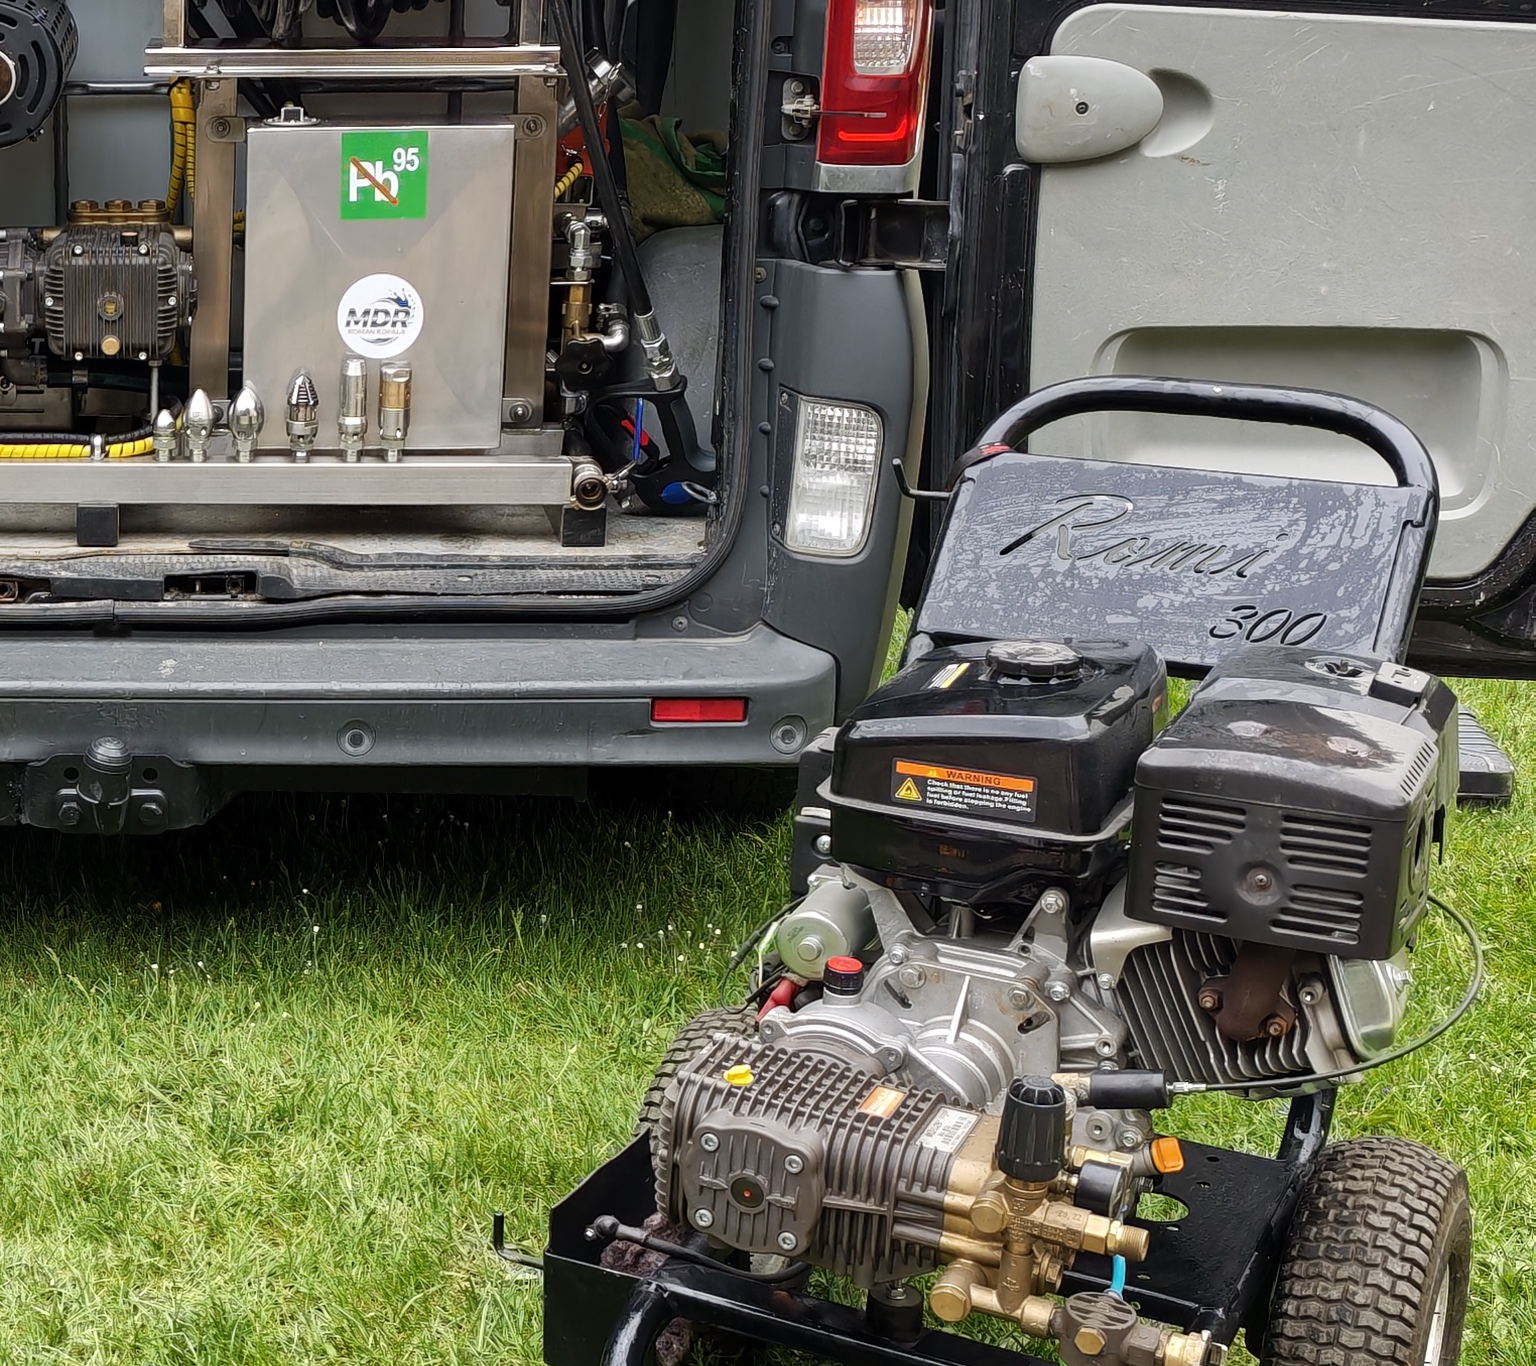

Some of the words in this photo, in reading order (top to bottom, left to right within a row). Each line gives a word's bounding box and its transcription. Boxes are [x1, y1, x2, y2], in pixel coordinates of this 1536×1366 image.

[392, 147, 420, 172] 95
[345, 308, 411, 328] MDR
[999, 493, 1289, 578] Romi
[1209, 604, 1328, 646] 300
[946, 770, 1001, 786] WARNING
